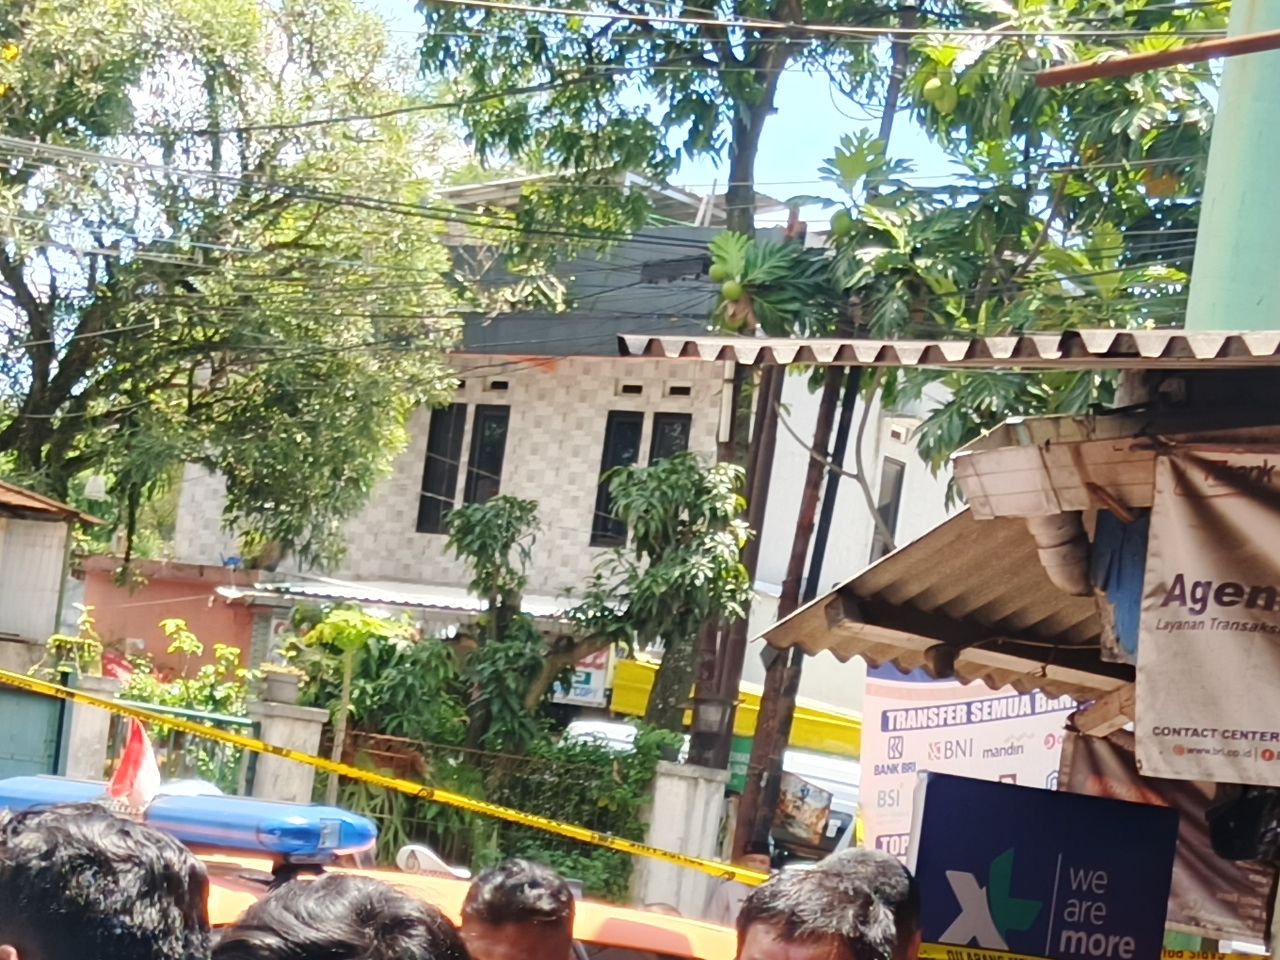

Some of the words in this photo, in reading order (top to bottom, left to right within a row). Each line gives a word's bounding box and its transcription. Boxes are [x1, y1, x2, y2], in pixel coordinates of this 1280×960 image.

[1156, 617, 1205, 633] Layanan
[886, 708, 968, 731] TRANSFER
[969, 693, 1033, 723] SEMUA
[1152, 726, 1218, 738] CONTACT
[1222, 728, 1280, 742] CENTER
[943, 738, 974, 760] BNI
[873, 763, 899, 776] BANK
[901, 761, 917, 774] BRI
[877, 788, 900, 809] BSI
[1070, 867, 1108, 895] we
[1063, 898, 1106, 926] are
[1059, 931, 1135, 960] more
